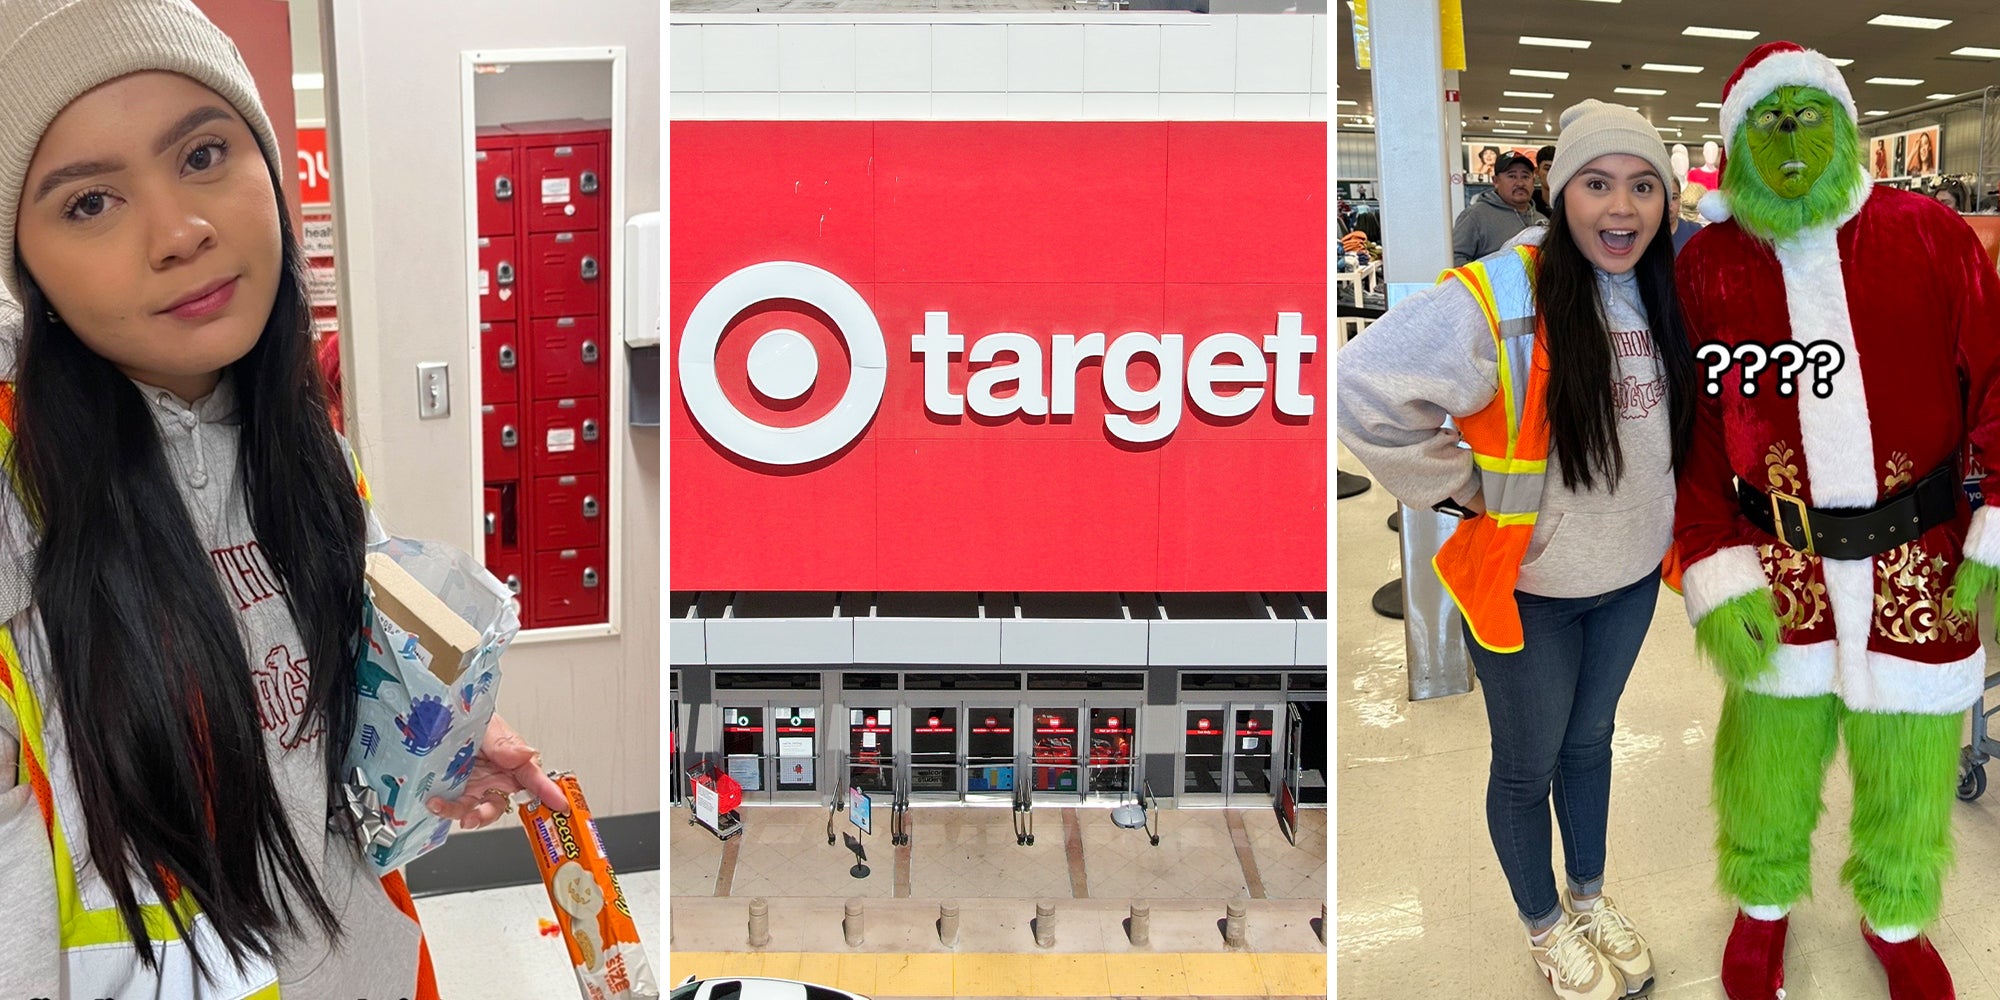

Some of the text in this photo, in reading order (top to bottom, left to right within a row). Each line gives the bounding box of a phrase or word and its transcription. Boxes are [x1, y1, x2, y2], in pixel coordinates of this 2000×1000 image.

[911, 311, 1317, 444] target
[1969, 492, 1985, 502] yo
[552, 811, 580, 860] eese's
